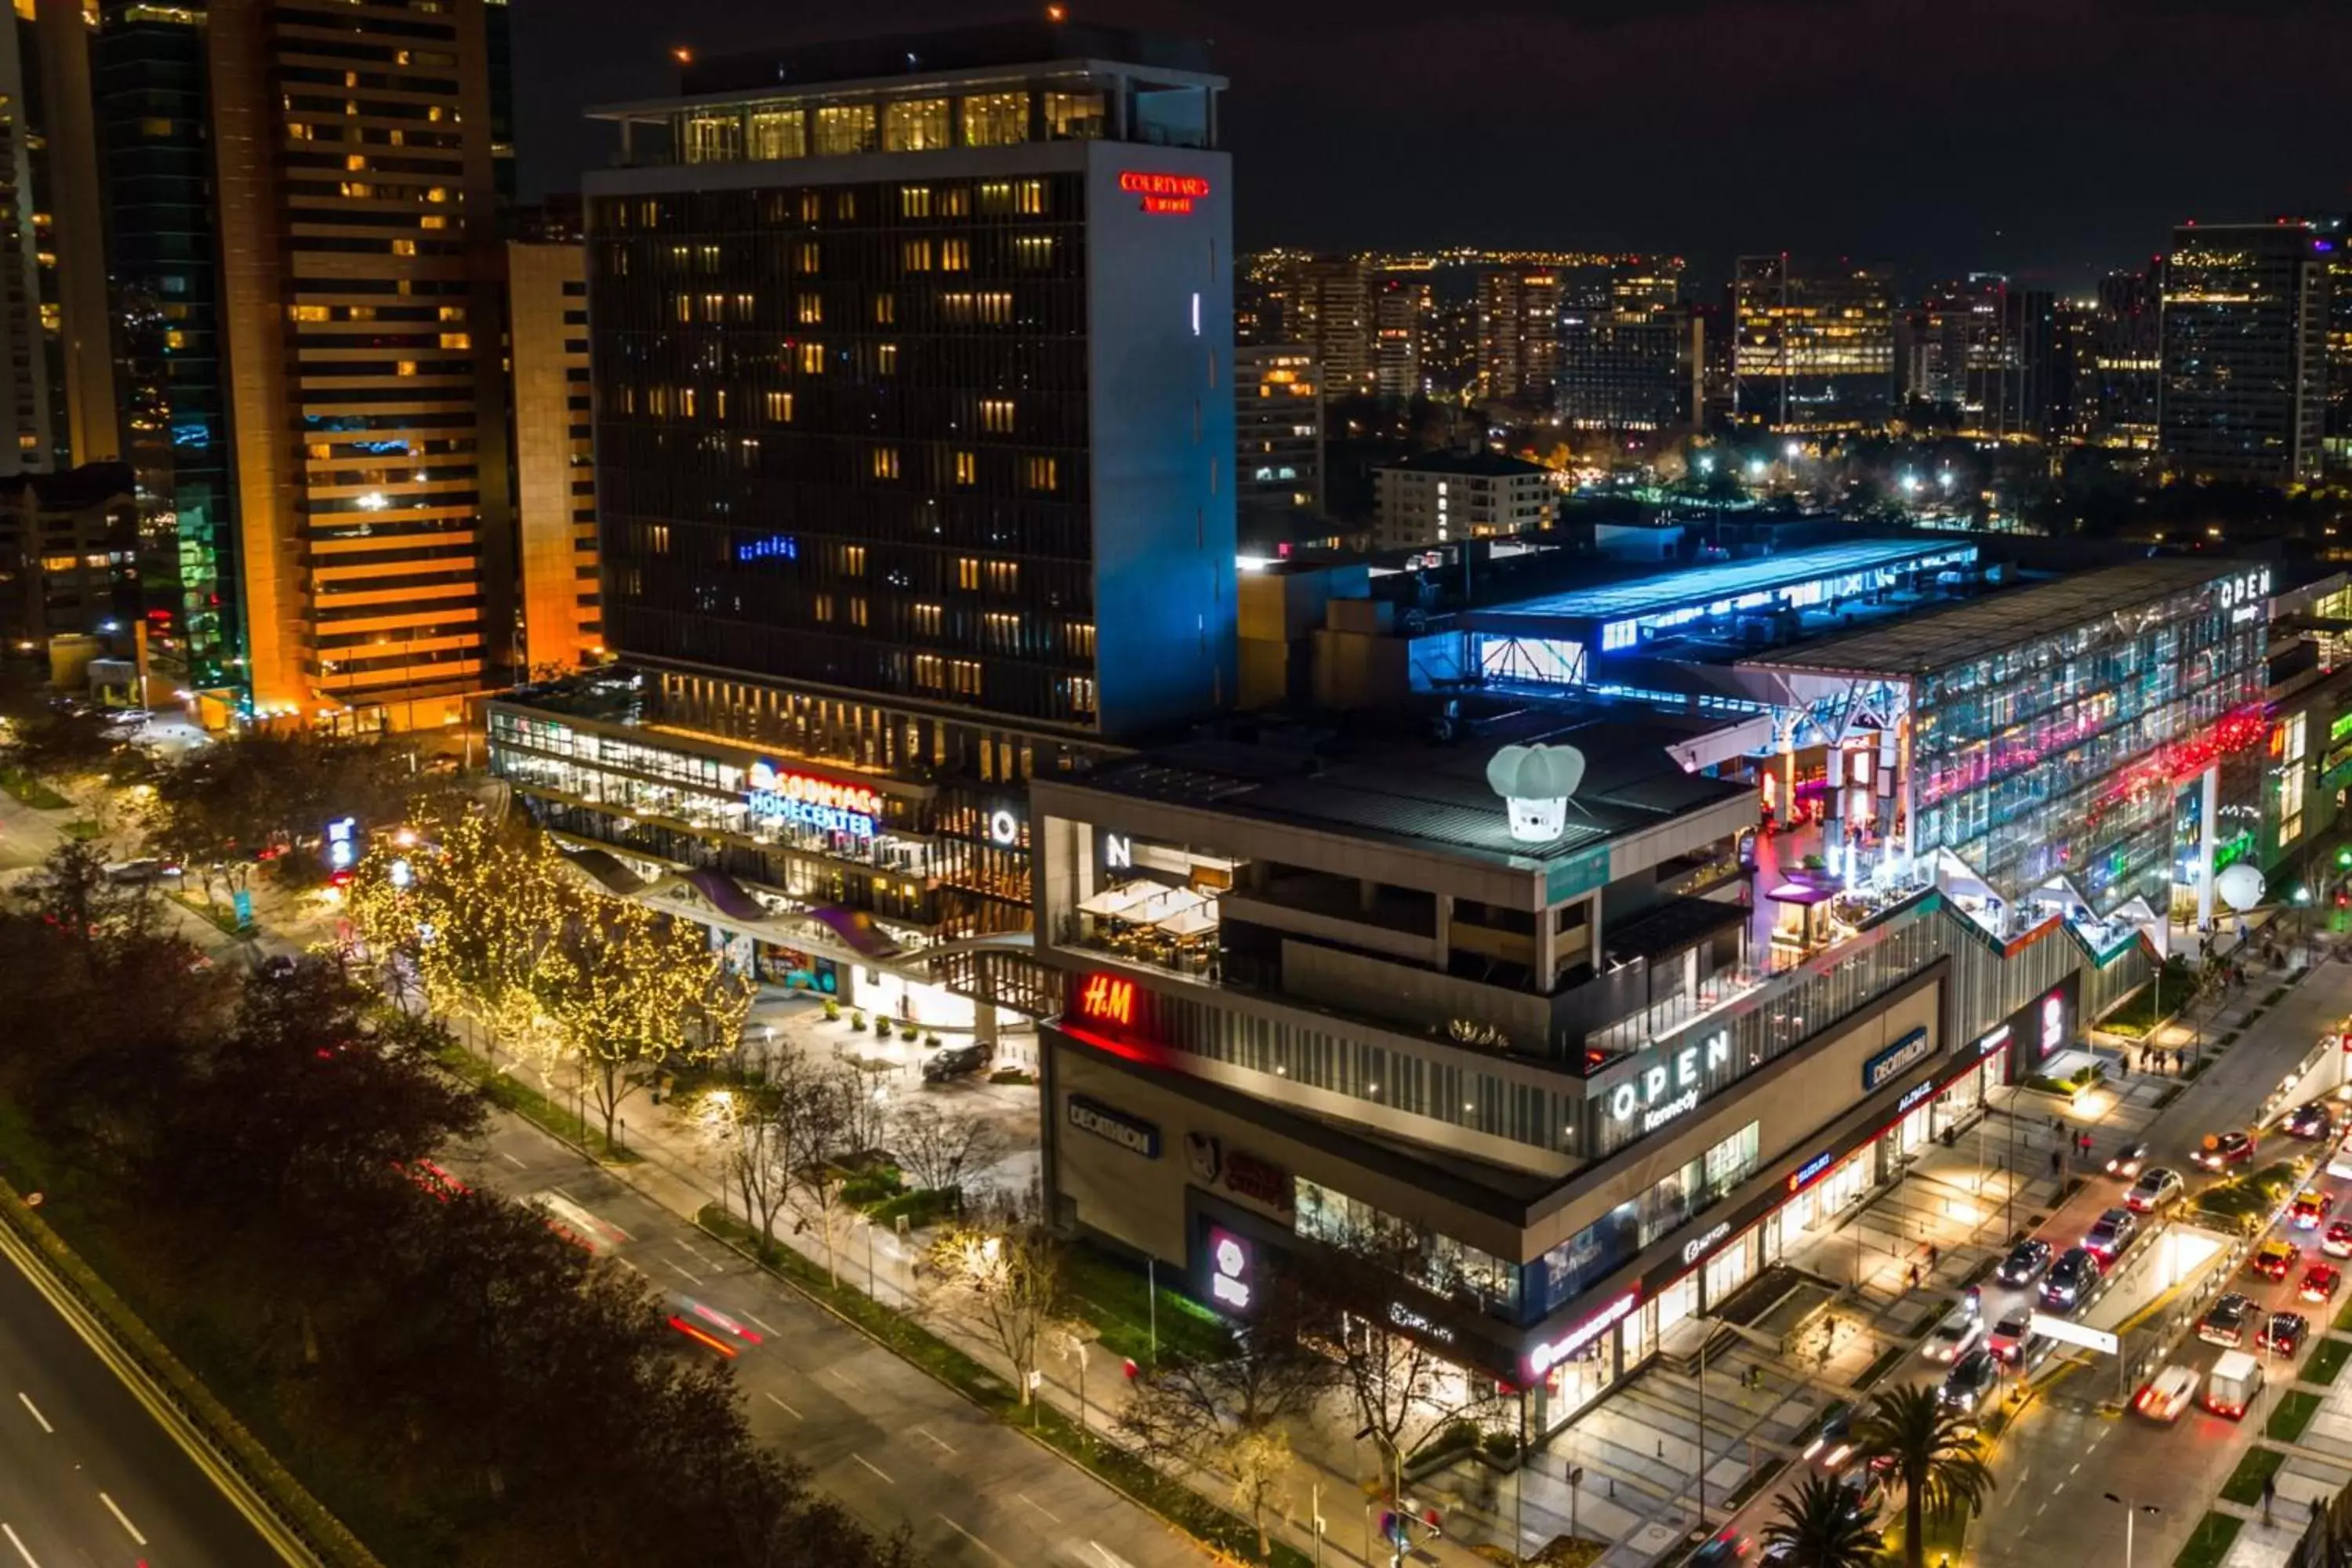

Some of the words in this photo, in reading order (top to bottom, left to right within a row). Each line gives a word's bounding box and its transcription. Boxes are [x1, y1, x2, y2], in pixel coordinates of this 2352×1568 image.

[2220, 569, 2270, 609] OPEN
[750, 791, 873, 837] HOMECENTER
[776, 771, 873, 815] SODIMAC
[1084, 975, 1133, 1025] H&M
[1613, 1029, 1729, 1121] OPEN
[1872, 1034, 1926, 1086] DECATHLON
[1069, 1103, 1149, 1155] DECATHLON
[1644, 1088, 1700, 1132] Kennedy
